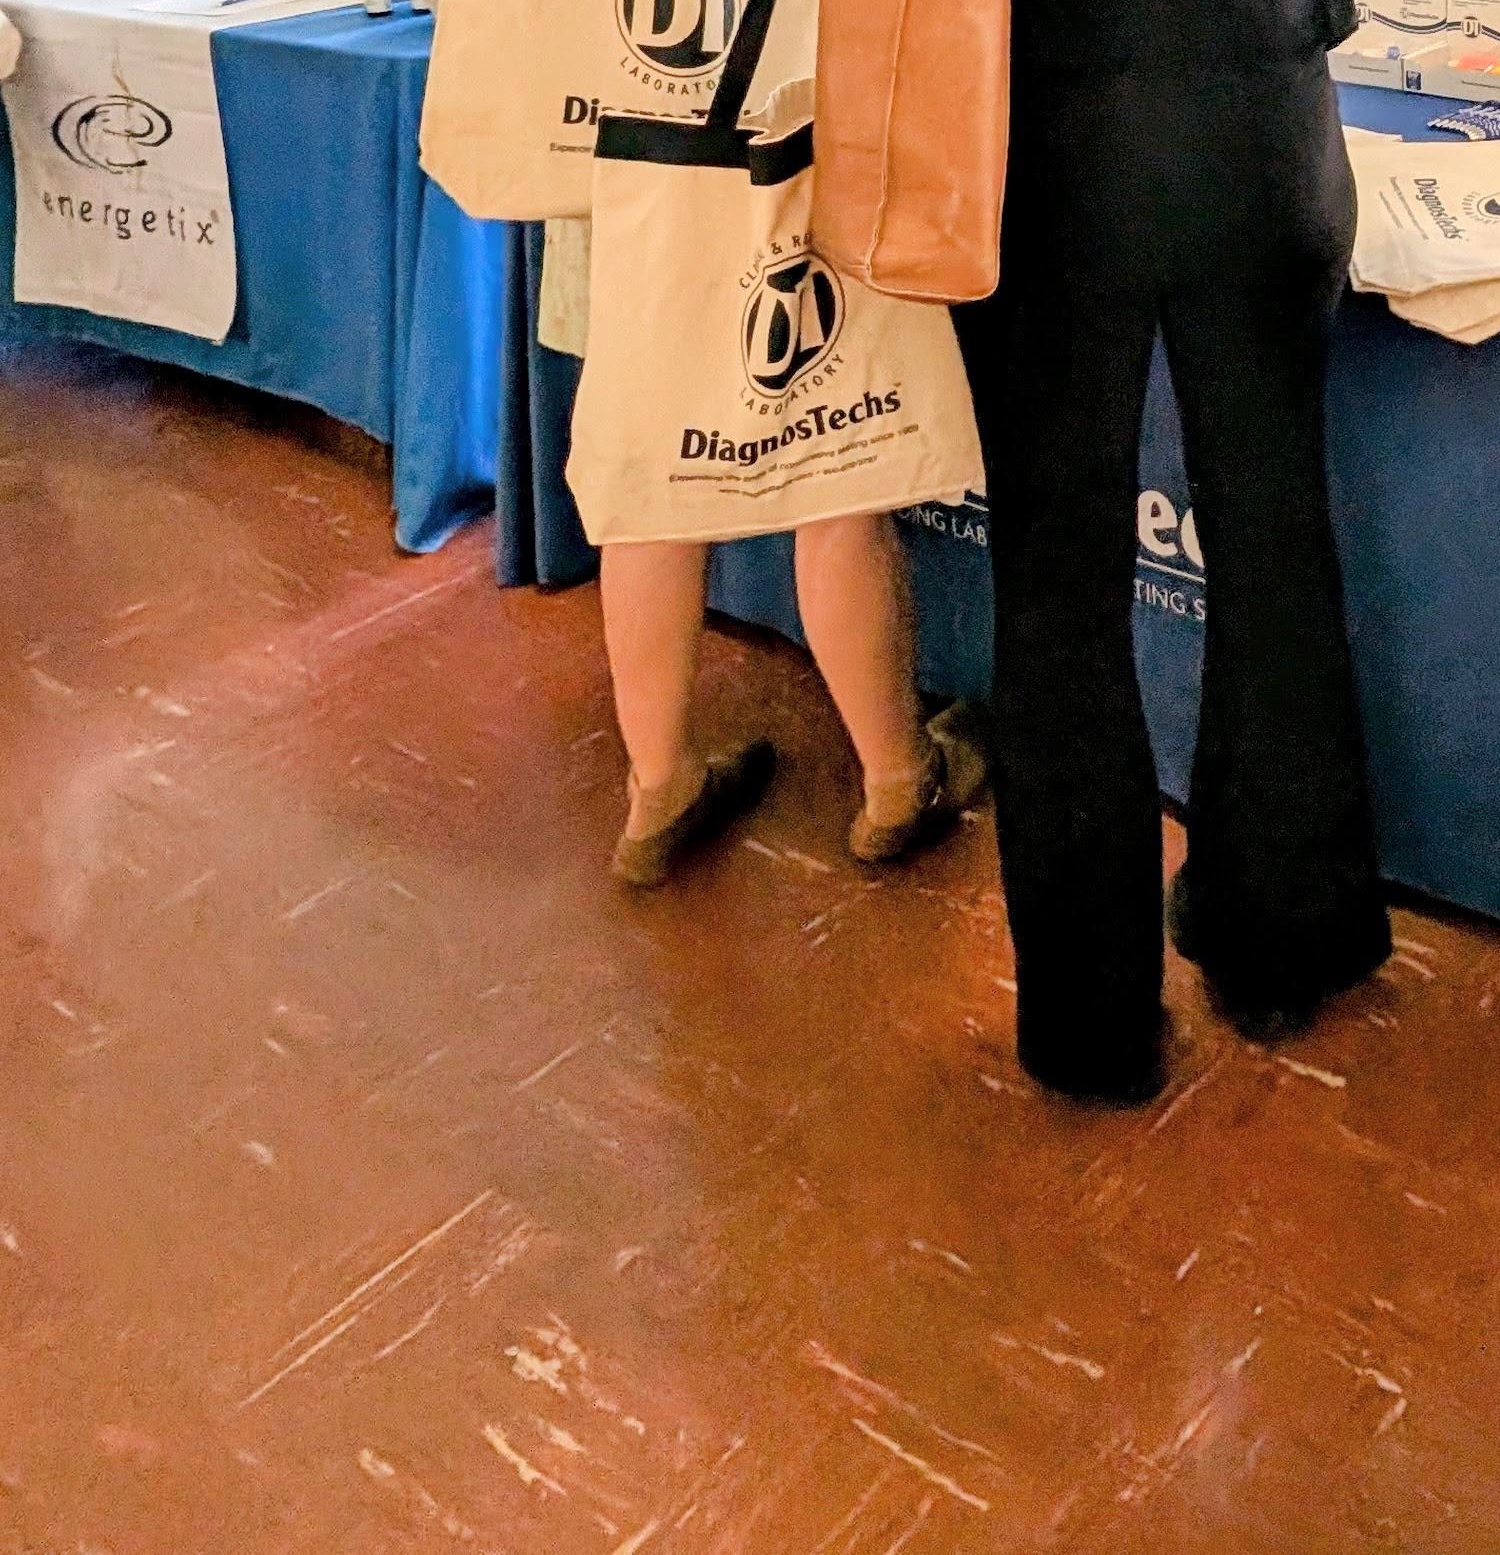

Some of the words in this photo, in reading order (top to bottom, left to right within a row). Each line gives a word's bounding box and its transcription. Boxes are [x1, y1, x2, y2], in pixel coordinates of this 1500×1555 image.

[619, 56, 717, 95] LABORATO
[41, 192, 215, 245] energetix
[680, 390, 902, 468] DiagnosTechs
